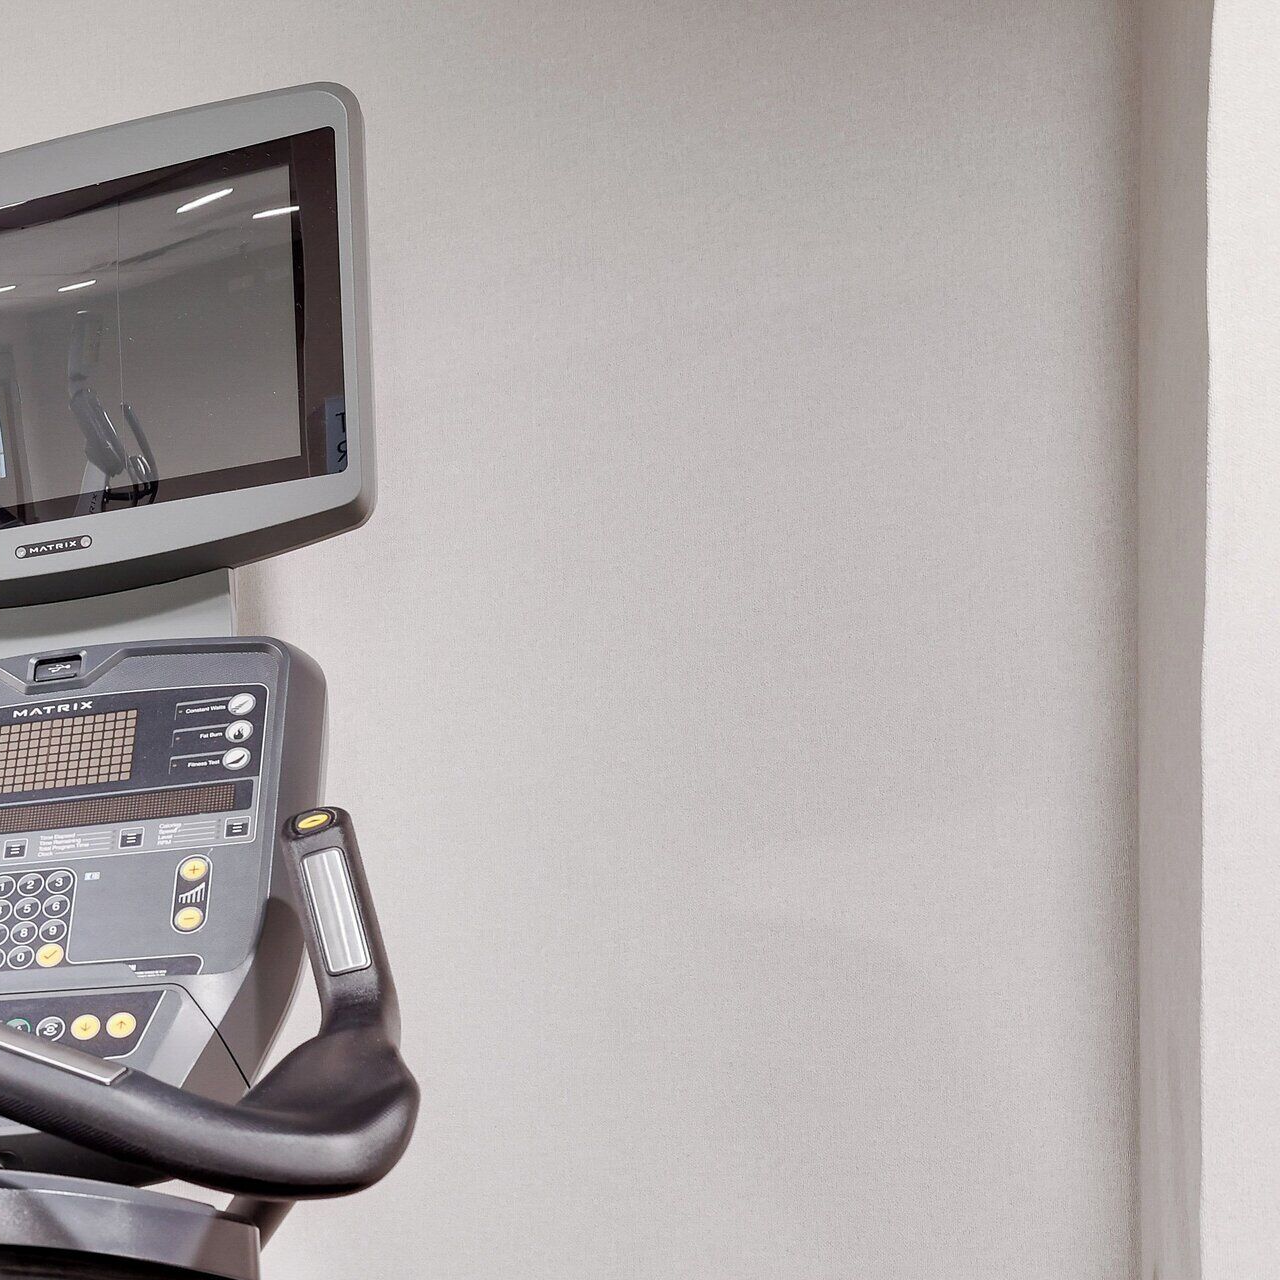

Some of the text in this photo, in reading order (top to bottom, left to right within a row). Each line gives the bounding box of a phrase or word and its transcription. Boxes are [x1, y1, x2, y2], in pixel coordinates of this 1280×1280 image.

[29, 540, 77, 554] MATRIX
[12, 701, 93, 718] MATRIX
[0, 877, 63, 891] 1 2 3
[23, 904, 32, 913] 5
[52, 902, 60, 911] 6
[20, 928, 28, 937] 8
[49, 926, 57, 935] 9
[16, 952, 25, 962] 0
